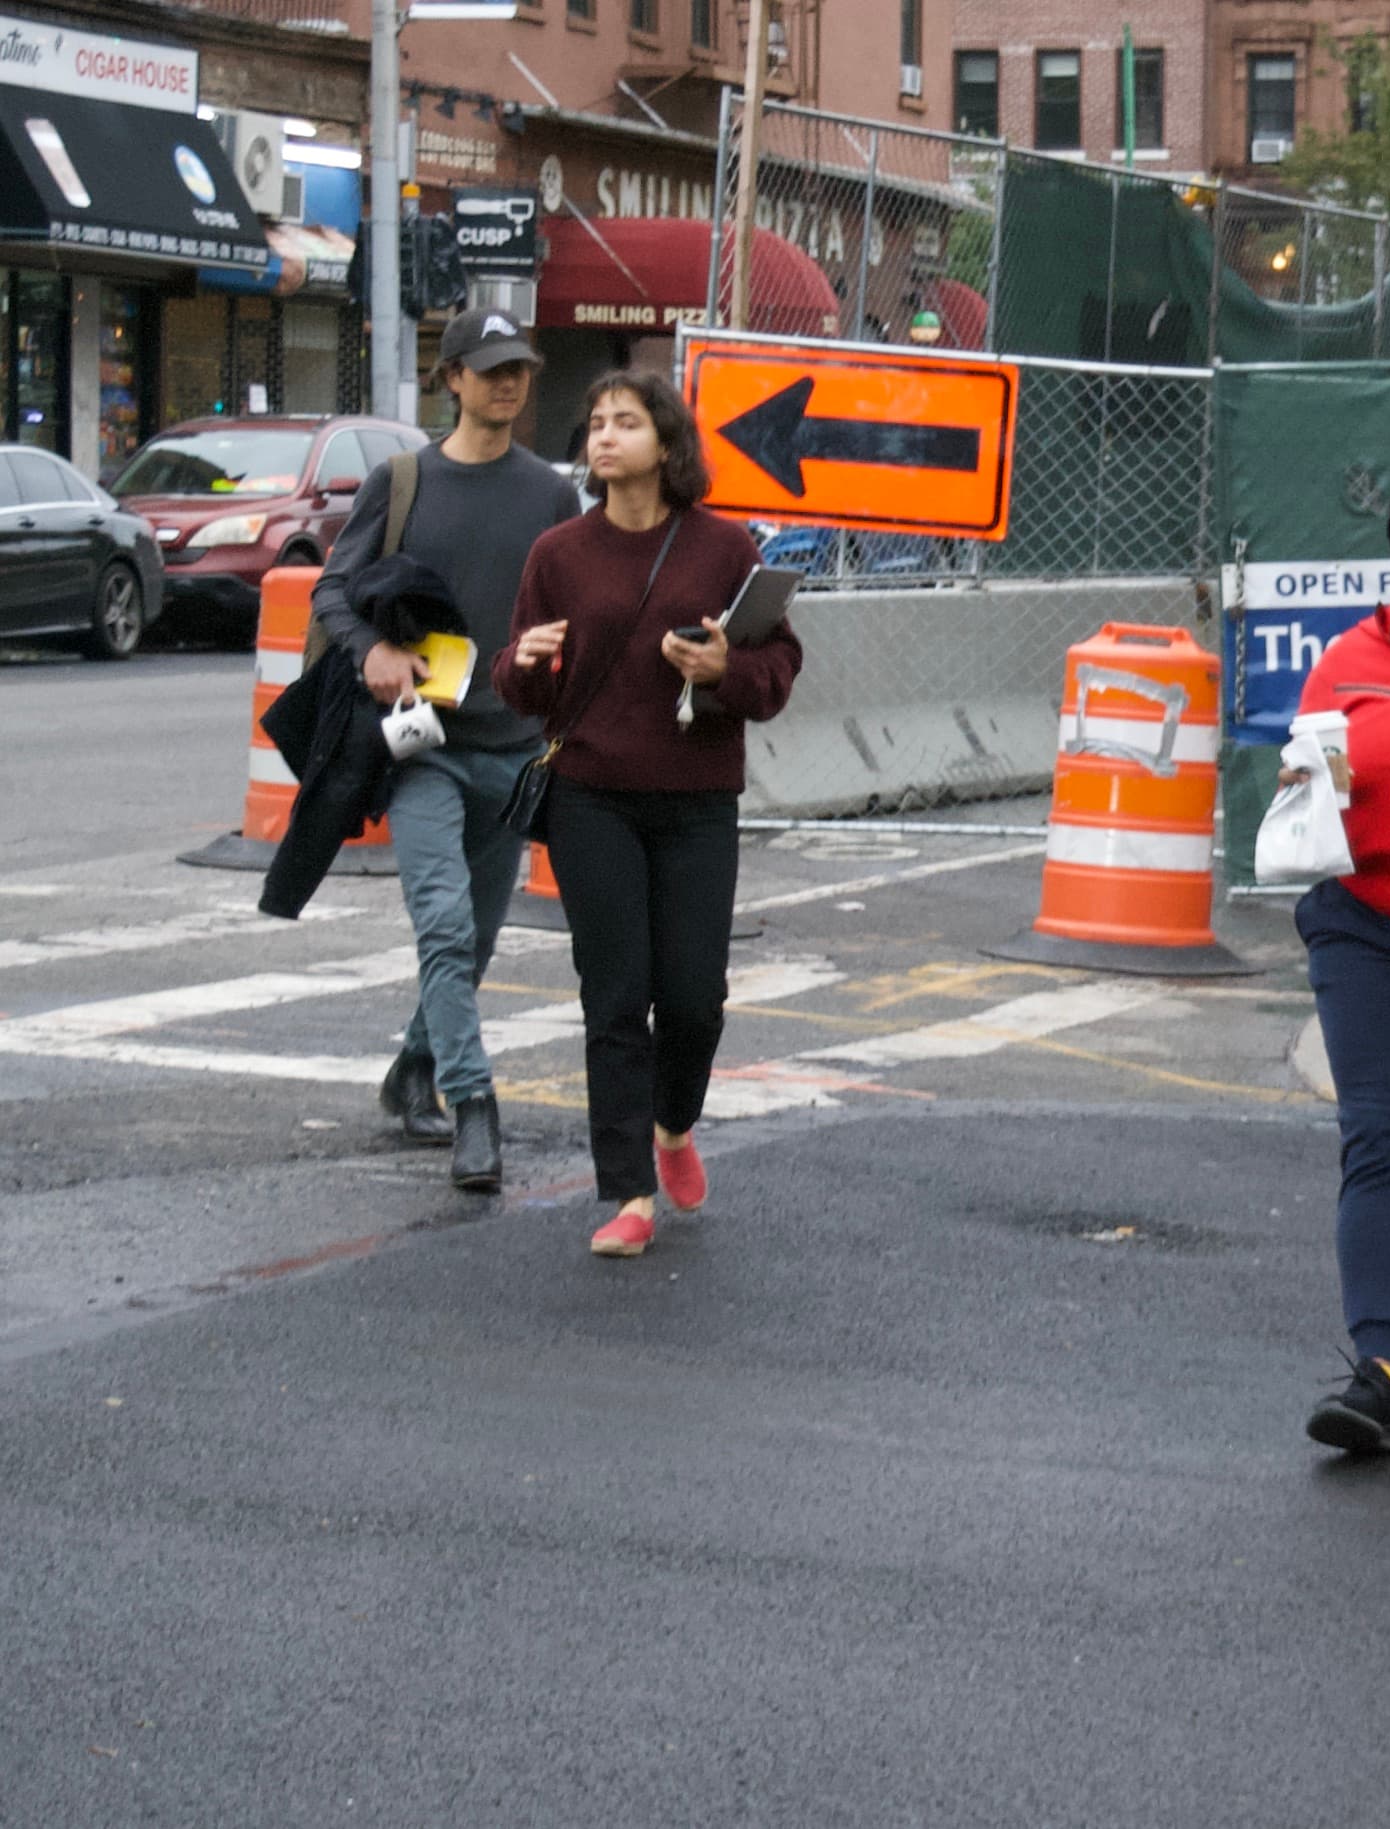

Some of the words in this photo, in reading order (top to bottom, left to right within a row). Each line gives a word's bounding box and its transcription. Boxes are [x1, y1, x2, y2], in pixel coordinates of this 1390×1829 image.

[75, 49, 129, 83] CIGAR
[131, 60, 190, 94] HOUSE
[597, 168, 733, 223] SMILIN
[456, 226, 512, 247] CUSP
[574, 305, 656, 325] SMILING
[1275, 571, 1364, 597] OPEN
